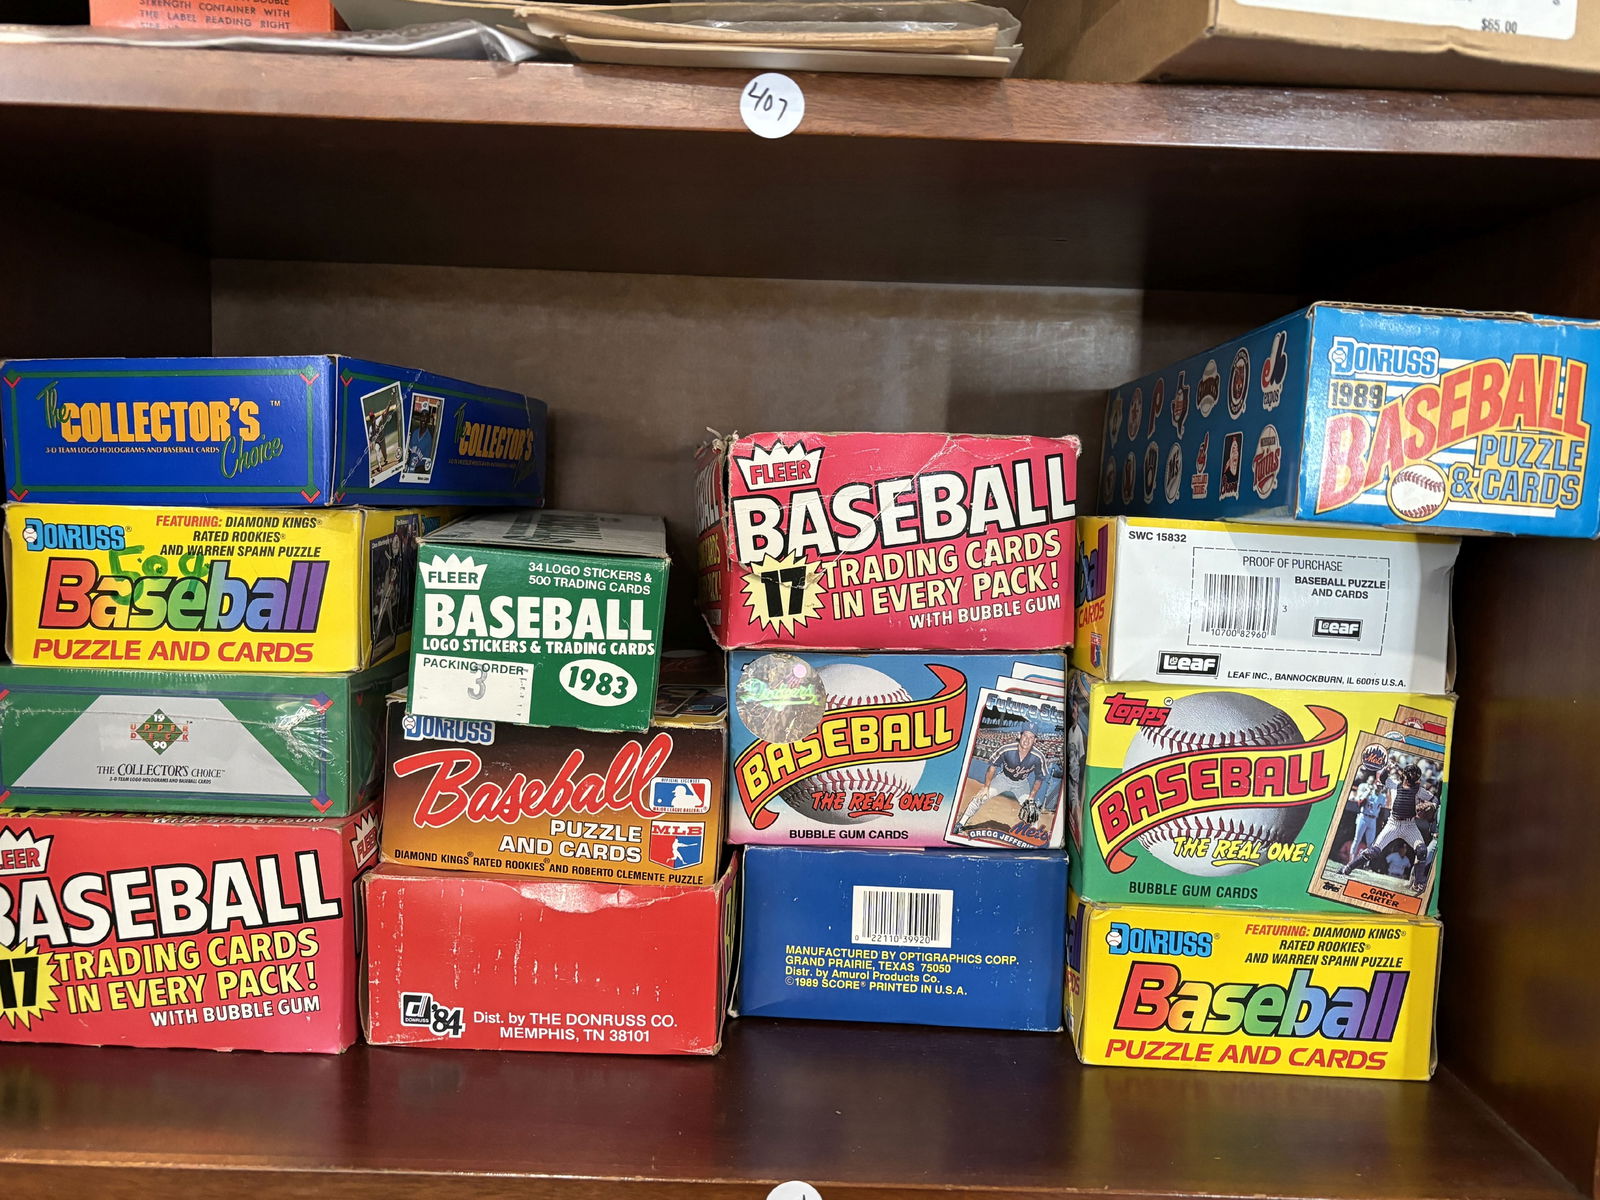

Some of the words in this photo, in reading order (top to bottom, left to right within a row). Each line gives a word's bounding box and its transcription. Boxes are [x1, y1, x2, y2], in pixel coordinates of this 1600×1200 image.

[140, 10, 159, 19] THE
[167, 12, 196, 23] LABEL
[205, 15, 252, 27] READING
[260, 20, 290, 30] RIGHT
[199, 3, 256, 15] CONTAINER
[264, 8, 290, 18] WITH
[748, 82, 788, 121] 407
[1329, 337, 1438, 377] DONRUSS
[1330, 381, 1384, 410] 1989
[61, 398, 261, 442] COLLECTOR'S
[459, 421, 534, 461] COLLECTOR'S
[1315, 354, 1591, 514] BASEBALL
[220, 434, 284, 478] Choice
[1478, 434, 1585, 472] PUZZLE
[750, 459, 812, 486] FLEER
[1480, 468, 1582, 506] CARDS
[731, 453, 1077, 563] BASEBALL
[156, 515, 222, 527] FEATURING:
[226, 516, 279, 528] DIAMOND
[193, 530, 228, 542] RATED
[1129, 531, 1154, 542] SWC
[1156, 532, 1187, 543] 15832
[160, 545, 183, 555] AND
[187, 545, 235, 556] WARREN
[238, 546, 275, 557] SPAHN
[278, 546, 321, 558] PUZZLE
[528, 562, 544, 573] 34
[546, 563, 580, 576] LOGO
[583, 567, 641, 582] STICKERS
[643, 572, 653, 583] &
[760, 565, 808, 619] 17
[821, 545, 958, 588] TRADING
[965, 529, 1061, 568] CARDS
[1242, 556, 1275, 568] PROOF
[1277, 558, 1290, 568] OF
[1292, 559, 1343, 572] PURCHASE
[428, 571, 478, 584] FLEER
[528, 575, 551, 586] 500
[554, 577, 606, 591] TRADING
[609, 583, 651, 595] CARDS
[1294, 576, 1346, 587] BASEBALL
[1348, 578, 1386, 589] PUZZLE
[38, 556, 330, 634] Baseball
[831, 586, 864, 620] IN
[872, 571, 963, 614] EVERY
[1311, 588, 1333, 598] AND
[1335, 589, 1369, 599] CARDS
[424, 593, 652, 641] BASEBALL
[909, 609, 952, 629] WITH
[958, 601, 1021, 624] BUBBLE
[1026, 593, 1060, 613] GUM
[1211, 628, 1237, 637] 10700
[1239, 630, 1267, 639] 82960
[1317, 620, 1359, 635] Leaf
[33, 638, 141, 662] PUZZLE
[147, 640, 210, 662] AND
[218, 641, 314, 663] CARDS
[422, 637, 459, 651] LOGO
[462, 639, 526, 653] STICKERS
[530, 641, 542, 654] &
[546, 642, 606, 655] TRADING
[609, 643, 655, 656] CARDS
[423, 657, 478, 672] PACKING
[481, 662, 525, 676] ORDER
[567, 665, 630, 700] 1983
[1228, 671, 1250, 679] LEAF
[1252, 672, 1272, 681] INC.,
[1275, 673, 1344, 685] BANNOCKBURN,
[1347, 676, 1354, 684] IL
[1356, 677, 1379, 686] 60015
[1381, 678, 1406, 687] U.S.A.
[130, 723, 189, 732] UPPER
[130, 732, 189, 740] DECK
[741, 706, 953, 801] BASEBALL
[97, 765, 115, 774] THE
[393, 732, 673, 828] Baseball
[811, 792, 845, 811] THE
[848, 791, 895, 811] REAL
[899, 792, 943, 812] ONE!
[1097, 749, 1331, 841] BASEBALL
[549, 818, 643, 843] PUZZLE
[651, 825, 702, 835] MLB
[789, 829, 836, 840] BUBBLE
[839, 829, 866, 840] GUM
[869, 830, 909, 840] CARDS
[969, 830, 998, 839] GREGG
[499, 835, 552, 856] AND
[559, 842, 642, 864] CARDS
[1173, 837, 1209, 858] THE
[1214, 838, 1260, 860] REAL
[1265, 842, 1315, 864] ONE!
[394, 850, 437, 862] DIAMOND
[474, 857, 502, 869] RATED
[550, 864, 569, 873] AND
[572, 866, 614, 877] ROBERTO
[617, 869, 665, 882] CLEMENTE
[669, 874, 703, 885] PUZZLE
[1129, 881, 1178, 895] BUBBLE
[1182, 884, 1214, 897] GUM
[1218, 886, 1258, 900] CARDS
[1360, 892, 1400, 907] CARTER
[1369, 888, 1396, 899] GARY
[872, 933, 899, 943] 22110
[903, 935, 930, 944] 39920
[1245, 924, 1310, 937] FEATURING:
[1313, 927, 1365, 939] DIAMOND
[54, 940, 200, 982] TRADING
[208, 928, 320, 966] CARDS
[786, 945, 878, 959] MANUFACTURED
[882, 951, 895, 960] BY
[899, 952, 982, 964] OPTIGRAPHICS
[985, 955, 1019, 965] CORP.
[1279, 940, 1314, 951] RATED
[786, 957, 825, 967] GRAND
[829, 959, 875, 971] PRAIRIE,
[878, 961, 915, 972] TEXAS
[921, 963, 951, 973] 75050
[1245, 953, 1268, 963] AND
[1272, 953, 1318, 965] WARREN
[1321, 955, 1358, 966] SPAHN
[1361, 957, 1403, 968] PUZZLE
[786, 966, 813, 977] Distr.
[816, 968, 828, 979] by
[832, 969, 869, 980] Amurol
[873, 971, 920, 982] Products
[923, 973, 940, 983] Co.
[66, 981, 102, 1015] IN
[109, 973, 207, 1011] EVERY
[869, 982, 918, 993] PRINTED
[921, 984, 932, 994] IN
[935, 985, 968, 996] U.S.A.
[1114, 960, 1411, 1042] Baseball
[150, 1008, 198, 1028] WITH
[204, 1001, 274, 1023] BUBBLE
[278, 995, 321, 1017] GUM
[473, 1011, 504, 1024] Dist.
[509, 1012, 525, 1026] by
[529, 1012, 561, 1026] THE
[567, 1013, 646, 1027] DONRUSS
[650, 1014, 678, 1028] CO.
[500, 1027, 579, 1043] MEMPHIS,
[584, 1029, 604, 1042] TN
[609, 1029, 650, 1043] 38101
[1105, 1039, 1214, 1064] PUZZLE
[1218, 1044, 1281, 1066] AND
[1288, 1047, 1387, 1071] CARDS
